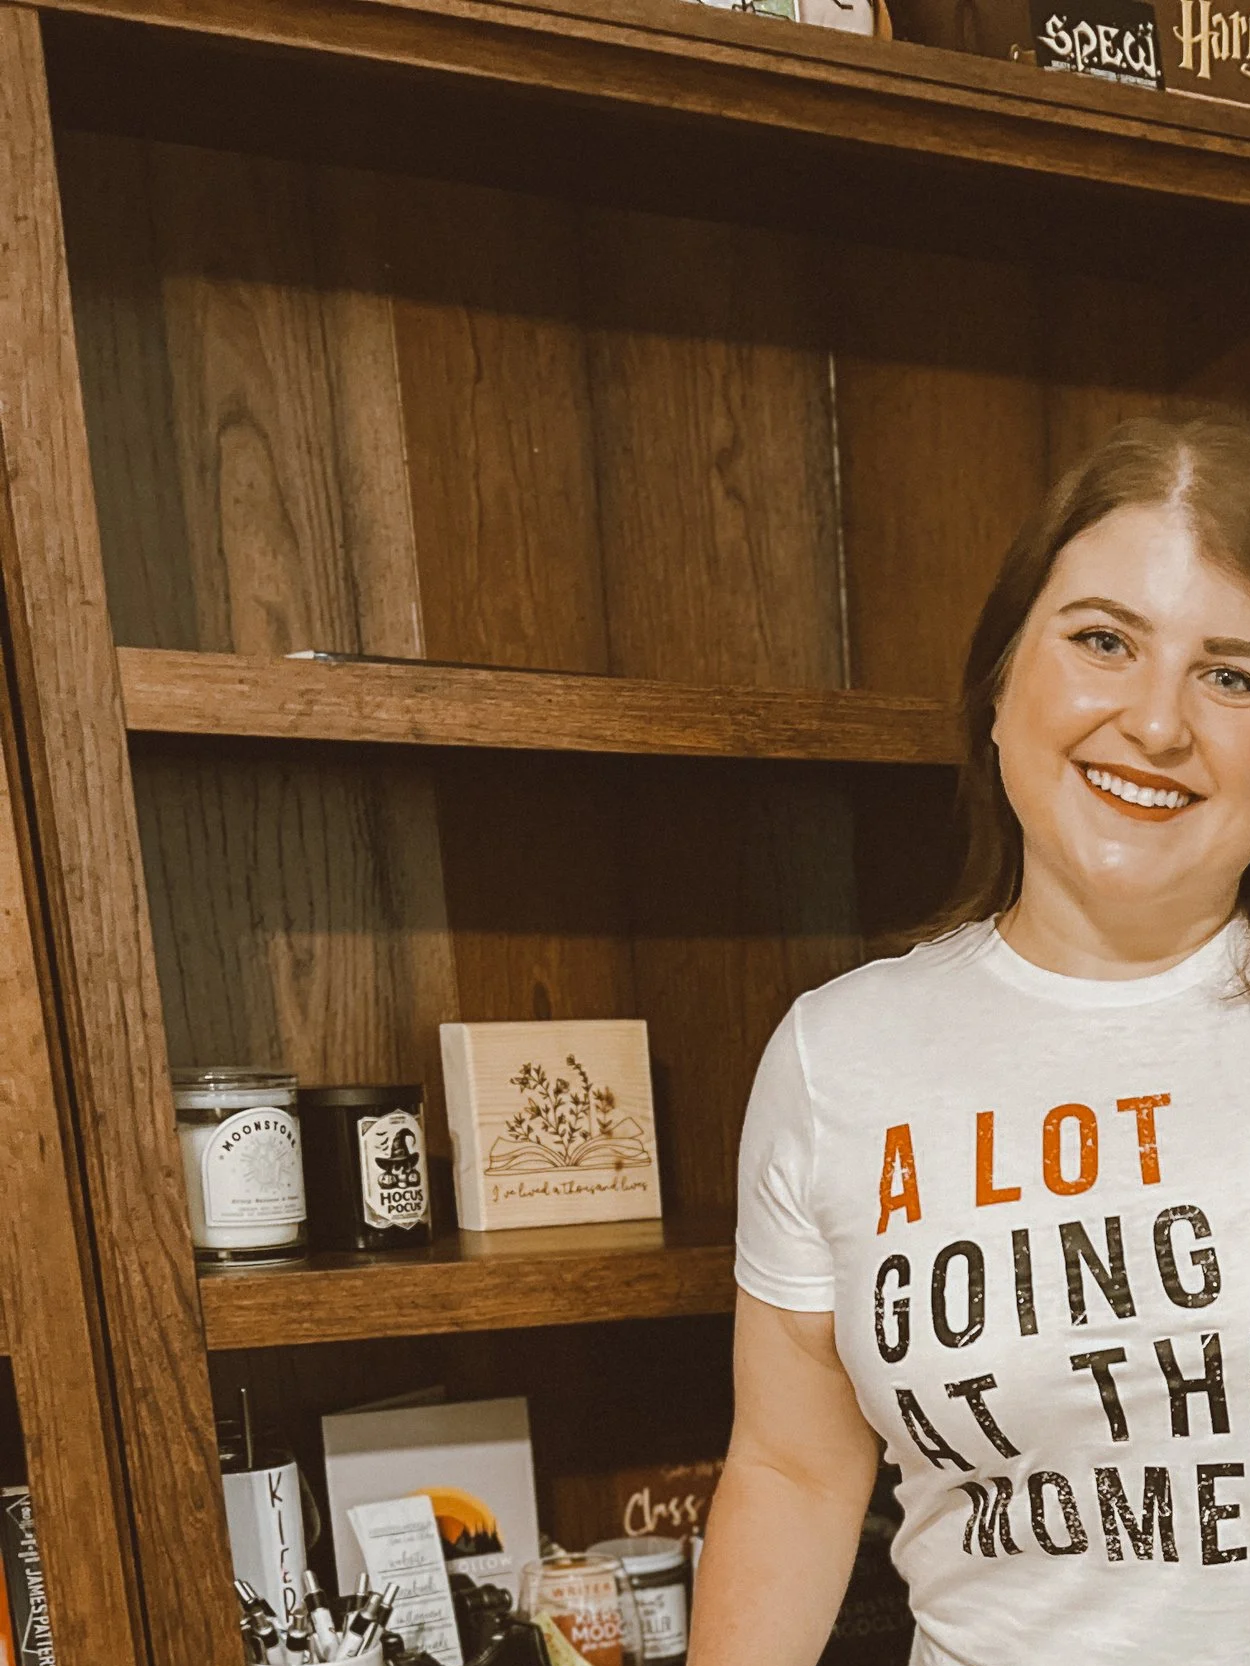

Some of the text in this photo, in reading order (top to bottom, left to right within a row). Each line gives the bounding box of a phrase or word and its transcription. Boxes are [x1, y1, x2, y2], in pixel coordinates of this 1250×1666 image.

[380, 1189, 423, 1206] HOCUS
[388, 1203, 422, 1214] POCUS
[876, 1093, 1172, 1235] A LOT
[874, 1203, 1223, 1364] GOING
[894, 1373, 1021, 1472] AT
